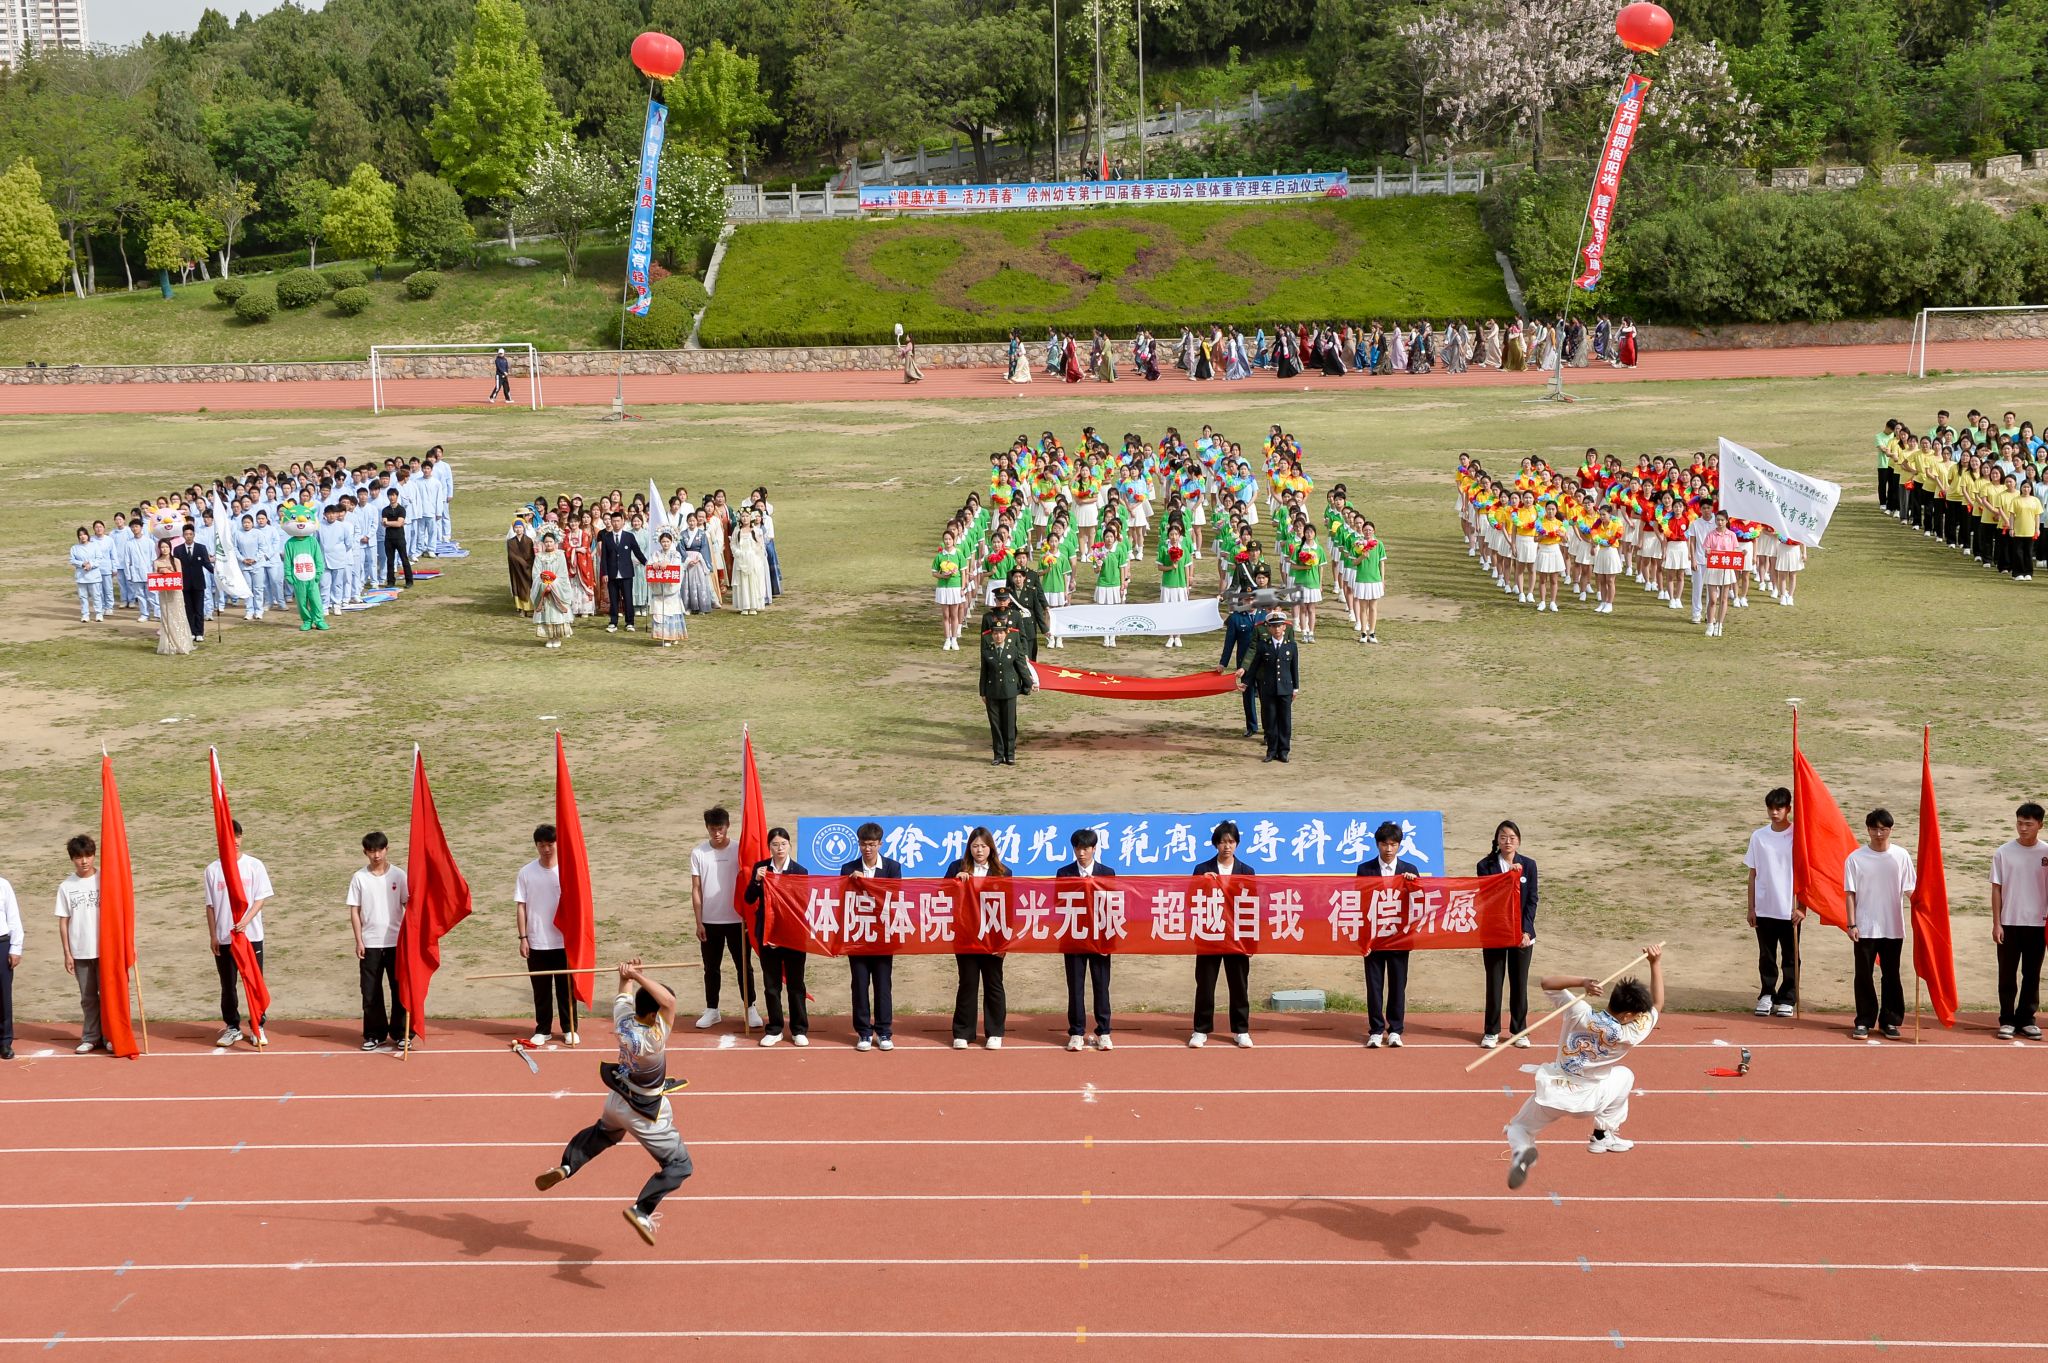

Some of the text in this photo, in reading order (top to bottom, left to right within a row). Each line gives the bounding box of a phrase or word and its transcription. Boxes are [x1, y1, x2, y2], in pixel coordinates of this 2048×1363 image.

[1600, 97, 1640, 186] 迈开腿拥抱阳光
[1710, 555, 1742, 566] 学特院
[804, 888, 1479, 943] 体院体院 风光无限 超越自我 得偿所愿
